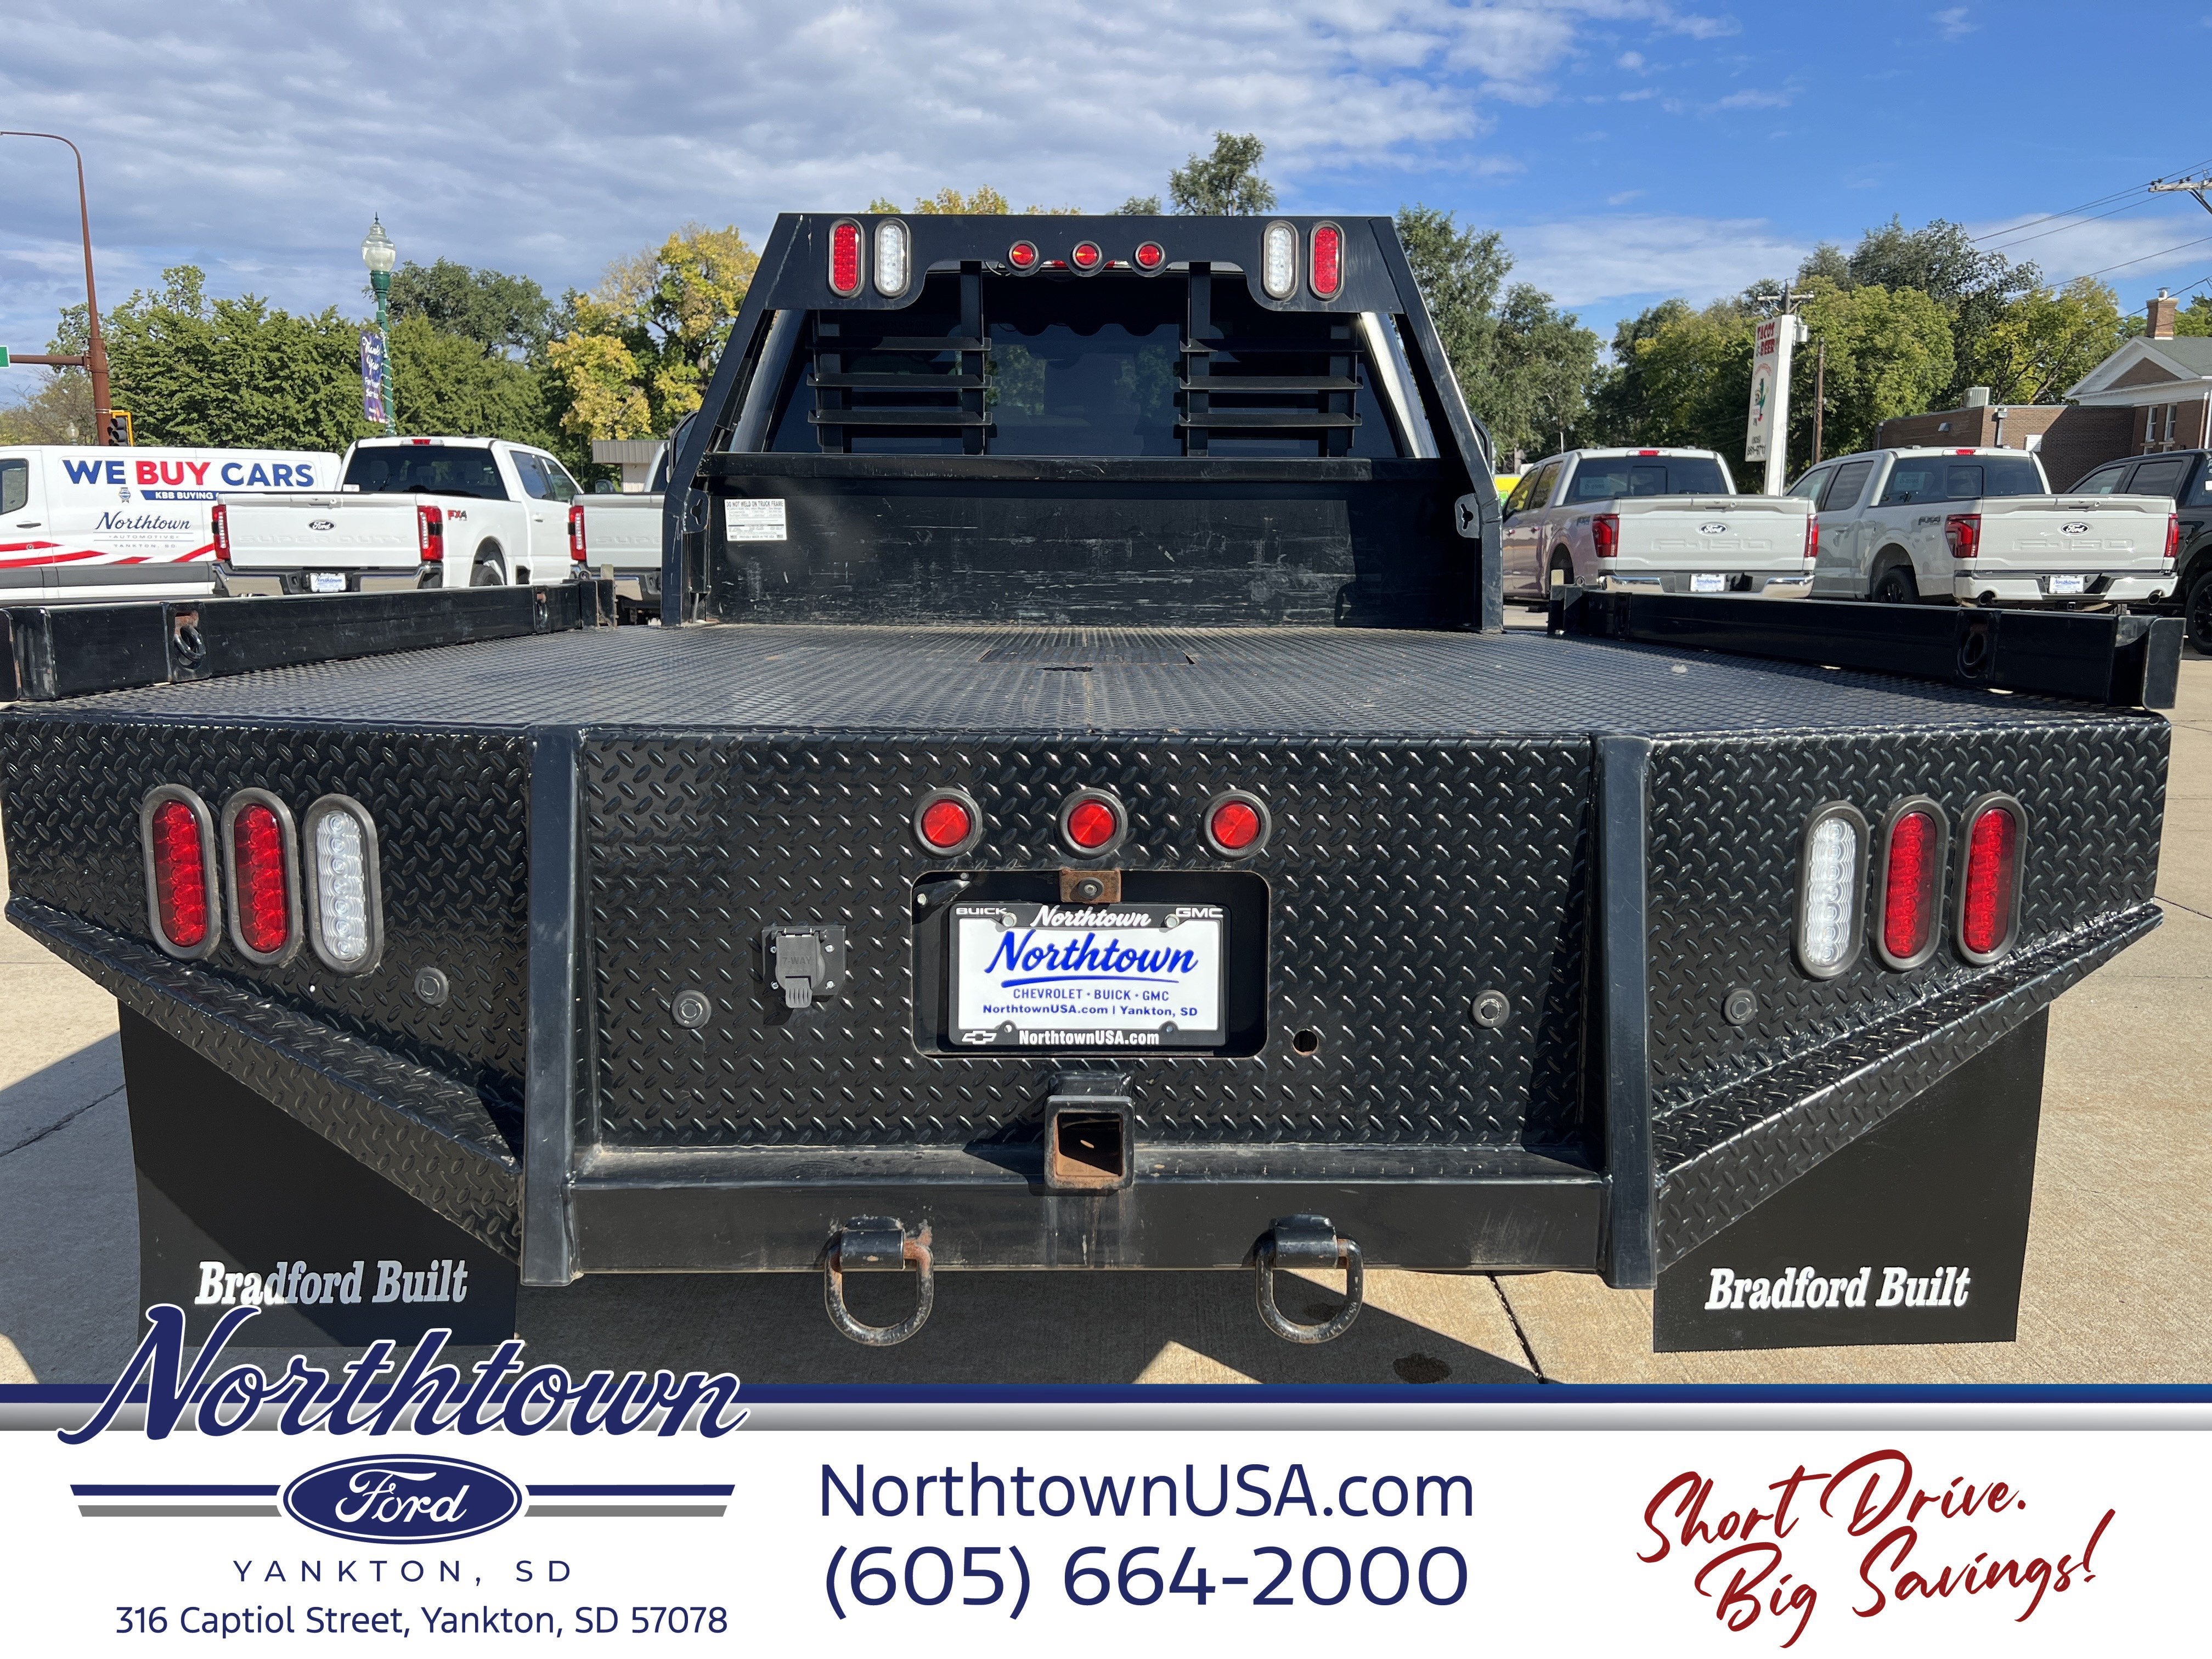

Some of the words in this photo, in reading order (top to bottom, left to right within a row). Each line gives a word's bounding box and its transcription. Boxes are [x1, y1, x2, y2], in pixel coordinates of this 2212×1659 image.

[62, 460, 126, 484] WE
[136, 461, 211, 486] BUY
[221, 462, 314, 487] CARS
[177, 492, 213, 500] BUYING
[94, 511, 191, 530] Northtown
[312, 521, 332, 531] Ford
[2066, 524, 2085, 533] Ford
[1651, 538, 1773, 551] F-150
[2012, 539, 2134, 551] F-150
[1030, 905, 1152, 927] Northtown
[1175, 907, 1223, 918] GMC
[984, 929, 1199, 974] Northtown
[782, 956, 811, 965] 7-WAY
[1013, 989, 1083, 999] CHEVROLET
[1094, 989, 1131, 1000] BUICK
[1142, 990, 1170, 1001] GMC
[983, 1004, 1108, 1014] NorthtownUSA.com
[1120, 1006, 1176, 1018] Yankton,
[1180, 1007, 1198, 1016] SD
[1019, 1030, 1159, 1045] NorthtownUSA.com
[194, 1260, 365, 1306] Bradford
[371, 1259, 469, 1303] Built
[1704, 1266, 1872, 1310] Bradford
[1875, 1266, 1971, 1307] Built
